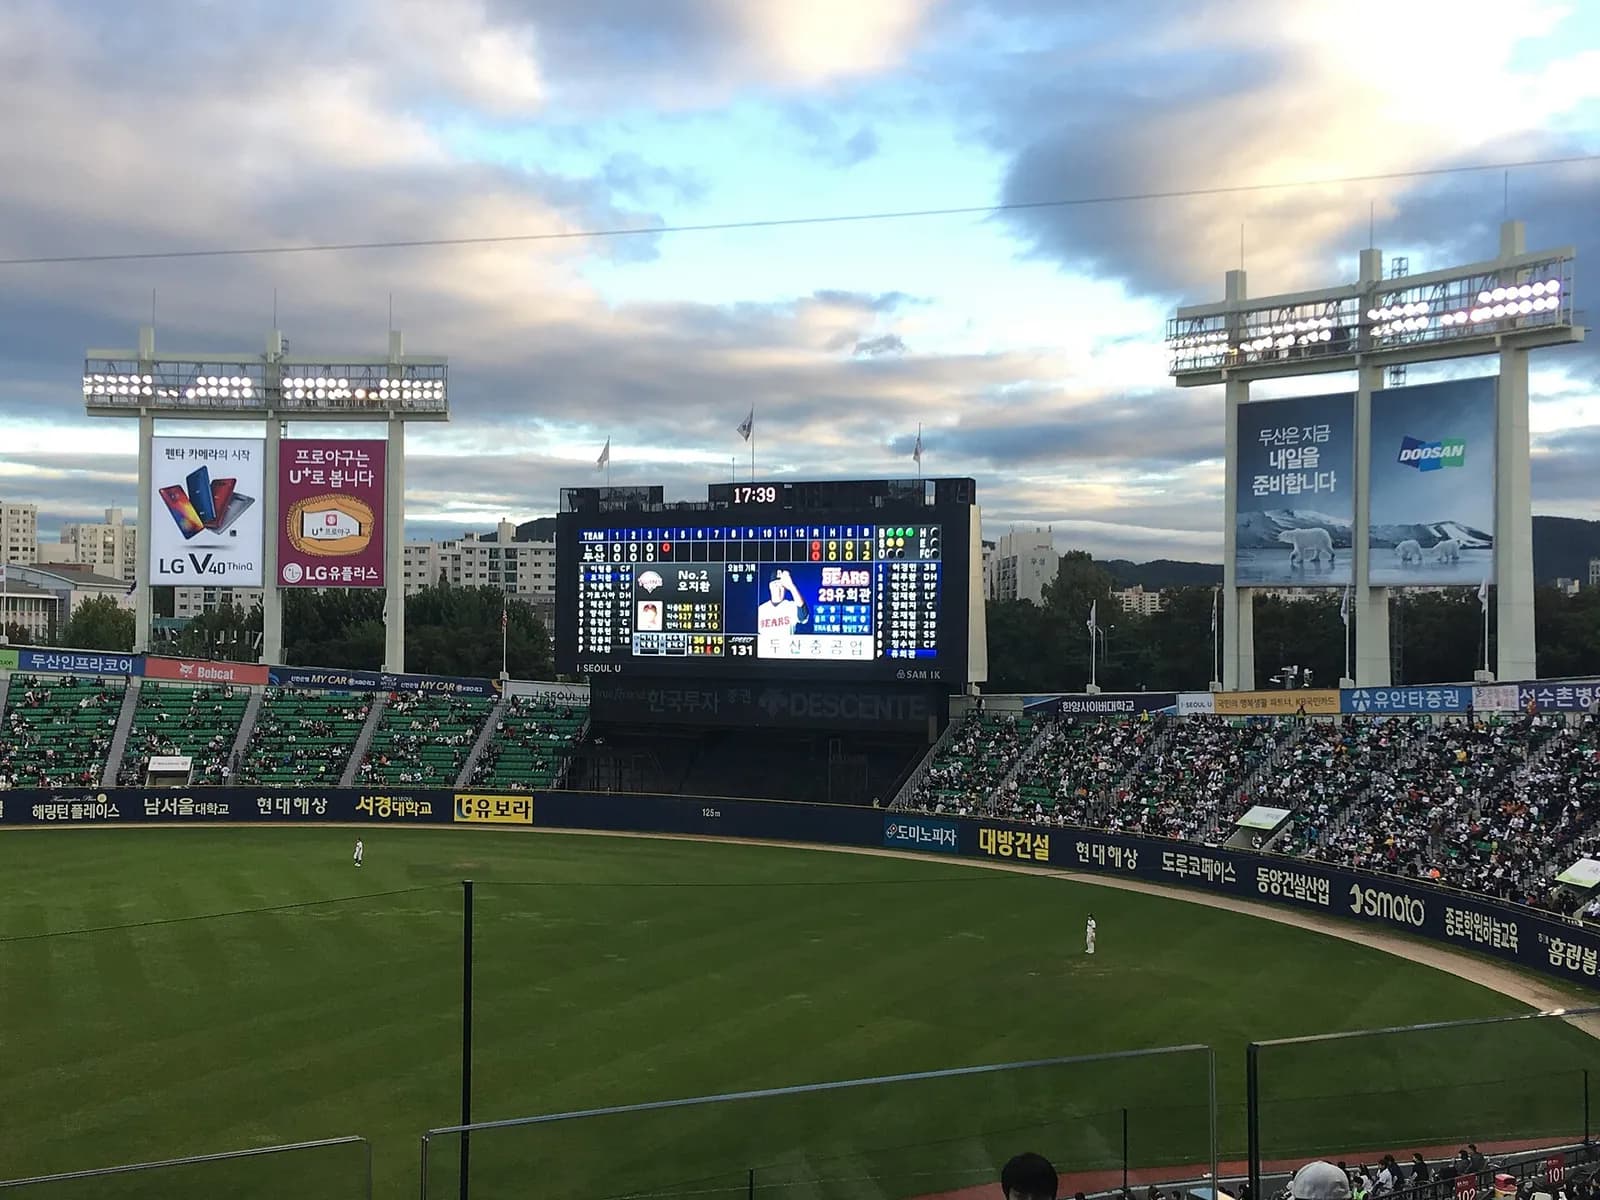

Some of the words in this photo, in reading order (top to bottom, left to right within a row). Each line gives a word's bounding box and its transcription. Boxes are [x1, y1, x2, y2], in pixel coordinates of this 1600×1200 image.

[1258, 426, 1300, 446] 두산은
[1302, 424, 1331, 443] 지금
[166, 448, 184, 460] 펜타
[188, 448, 228, 460] 카메라의
[232, 450, 250, 461] 시작
[296, 450, 370, 468] 프로야구는
[1270, 446, 1320, 470] 내일을
[1400, 445, 1464, 462] DOOSAN
[330, 470, 374, 488] 봅니다
[1252, 470, 1336, 496] 준비합니다
[734, 487, 776, 504] 17:39
[584, 532, 604, 540] TEAM
[631, 531, 636, 539] 2
[648, 530, 652, 539] 3
[664, 530, 669, 539] 4
[714, 530, 719, 538] 7
[763, 529, 772, 538] 10
[780, 529, 788, 538] 11
[796, 528, 804, 537] 12
[830, 528, 835, 537] H
[920, 528, 926, 537] H
[613, 543, 621, 552] 0
[630, 543, 637, 552] 0
[646, 543, 654, 552] 0
[662, 543, 670, 552] 0
[812, 541, 819, 550] 0
[829, 541, 836, 550] 0
[846, 541, 853, 550] 0
[864, 541, 870, 550] 1
[920, 539, 926, 548] E
[160, 558, 184, 574] LG
[189, 553, 226, 574] V40
[228, 562, 253, 571] ThinQ
[583, 552, 605, 562] 두산
[614, 553, 621, 562] 0
[630, 553, 637, 562] 0
[646, 553, 654, 562] 0
[812, 551, 819, 560] 0
[829, 551, 836, 560] 0
[846, 551, 853, 560] 0
[863, 551, 870, 560] 2
[306, 566, 378, 581] LG유플러스
[678, 570, 707, 580] No.2
[822, 568, 869, 586] BEARS
[678, 581, 710, 592] 오지환
[731, 645, 753, 656] 131
[31, 654, 132, 673] 두산인프라코어
[198, 666, 234, 680] Bobcat
[310, 675, 328, 683] MY
[327, 676, 348, 685] CAR
[907, 671, 927, 679] SAM
[420, 681, 437, 689] MY
[436, 682, 456, 691] CAR
[648, 689, 720, 714] 한국투자
[789, 693, 928, 720] DESCENTE
[1062, 701, 1134, 712] 한양사이버대학교
[1374, 690, 1459, 708] 유안타증권
[1520, 687, 1600, 708] 선수촌병
[71, 804, 119, 819] 플레이스
[144, 797, 230, 815] 남서울대학교
[257, 797, 328, 815] 현대해상
[355, 796, 432, 818] 서경대학교
[475, 799, 531, 819] 유보라
[702, 808, 720, 816] 125m
[896, 825, 957, 846] 도미노피자
[979, 828, 1049, 861] 대방건설
[1076, 841, 1138, 870] 현대해상
[1162, 851, 1236, 883] 도루코페이스
[1257, 867, 1330, 906] 동양건설산업
[1364, 888, 1425, 926] smato
[1445, 906, 1518, 954] 종로학원하늘교육
[1549, 1167, 1565, 1184] 101
